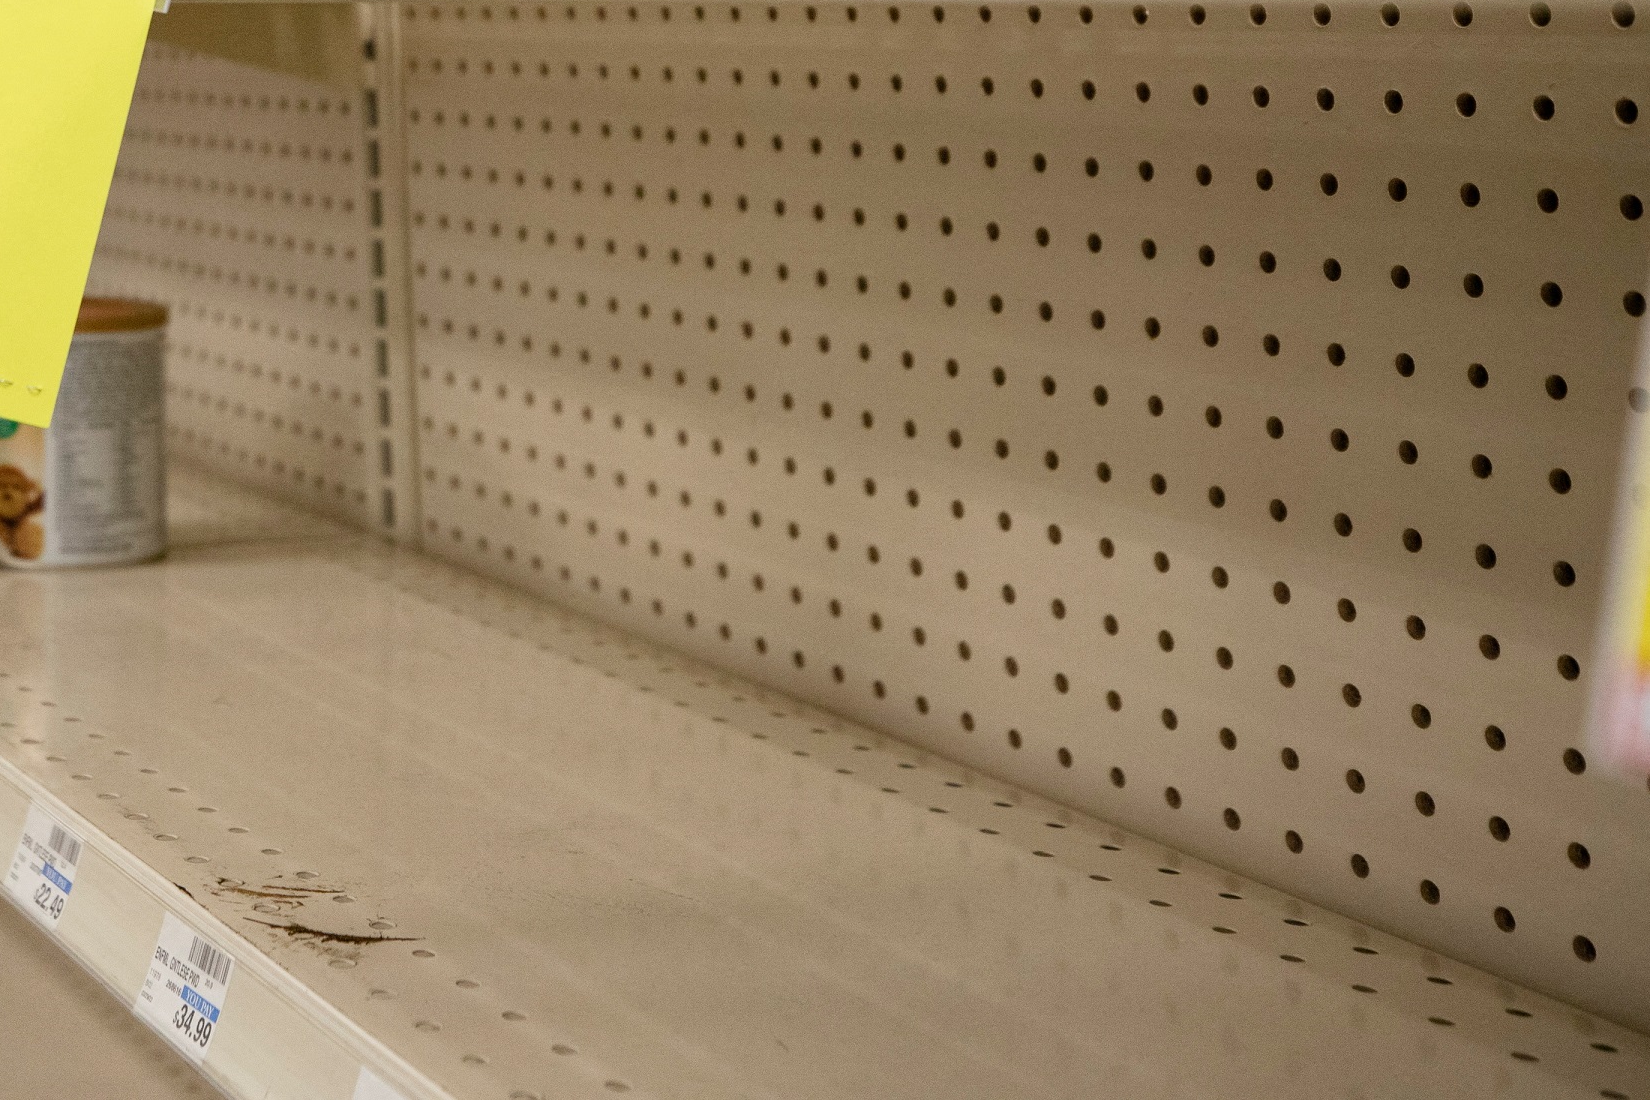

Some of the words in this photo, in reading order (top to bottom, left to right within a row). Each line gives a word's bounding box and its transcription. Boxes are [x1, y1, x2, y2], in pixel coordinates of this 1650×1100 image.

[33, 883, 65, 920] $22.49
[186, 989, 200, 1009] YOU
[199, 1000, 214, 1018] PAY
[172, 1003, 212, 1048] $34.99
